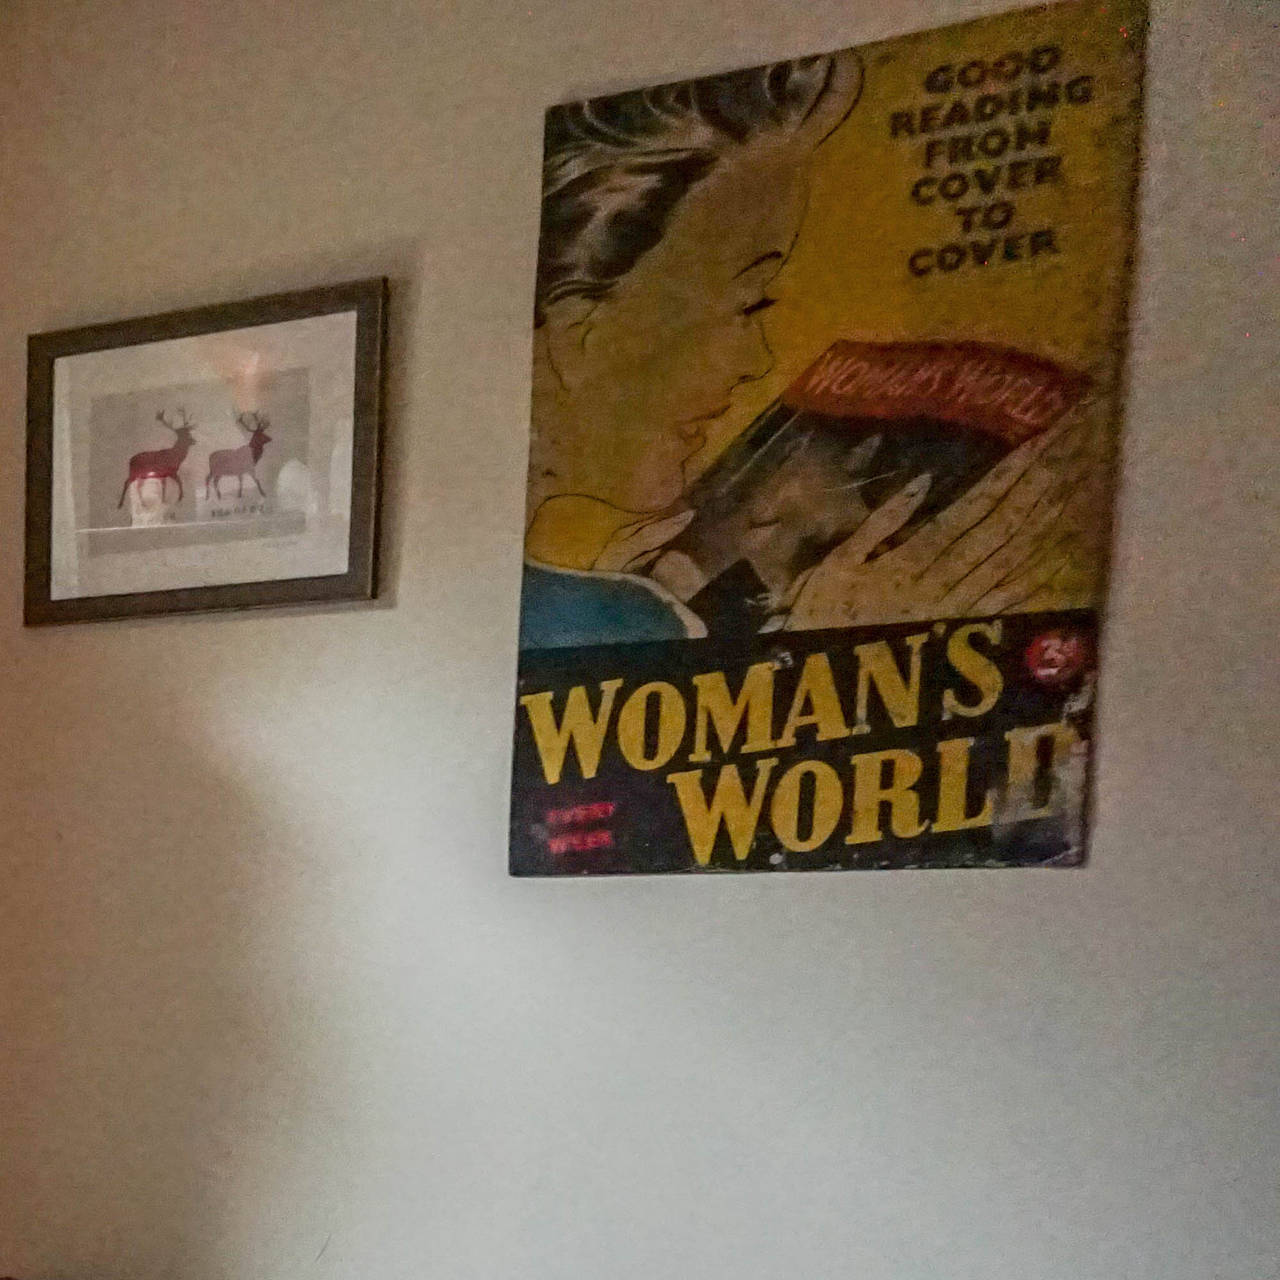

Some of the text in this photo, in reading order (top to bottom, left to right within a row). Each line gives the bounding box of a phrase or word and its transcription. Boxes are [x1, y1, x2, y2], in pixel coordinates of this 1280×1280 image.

[925, 45, 1061, 93] GOOD
[890, 75, 1094, 138] READING
[925, 121, 1051, 168] FROM
[911, 155, 1062, 206] COVER
[956, 201, 1016, 233] TO
[908, 230, 1061, 278] COVER
[520, 619, 1004, 786] WOMAN'S
